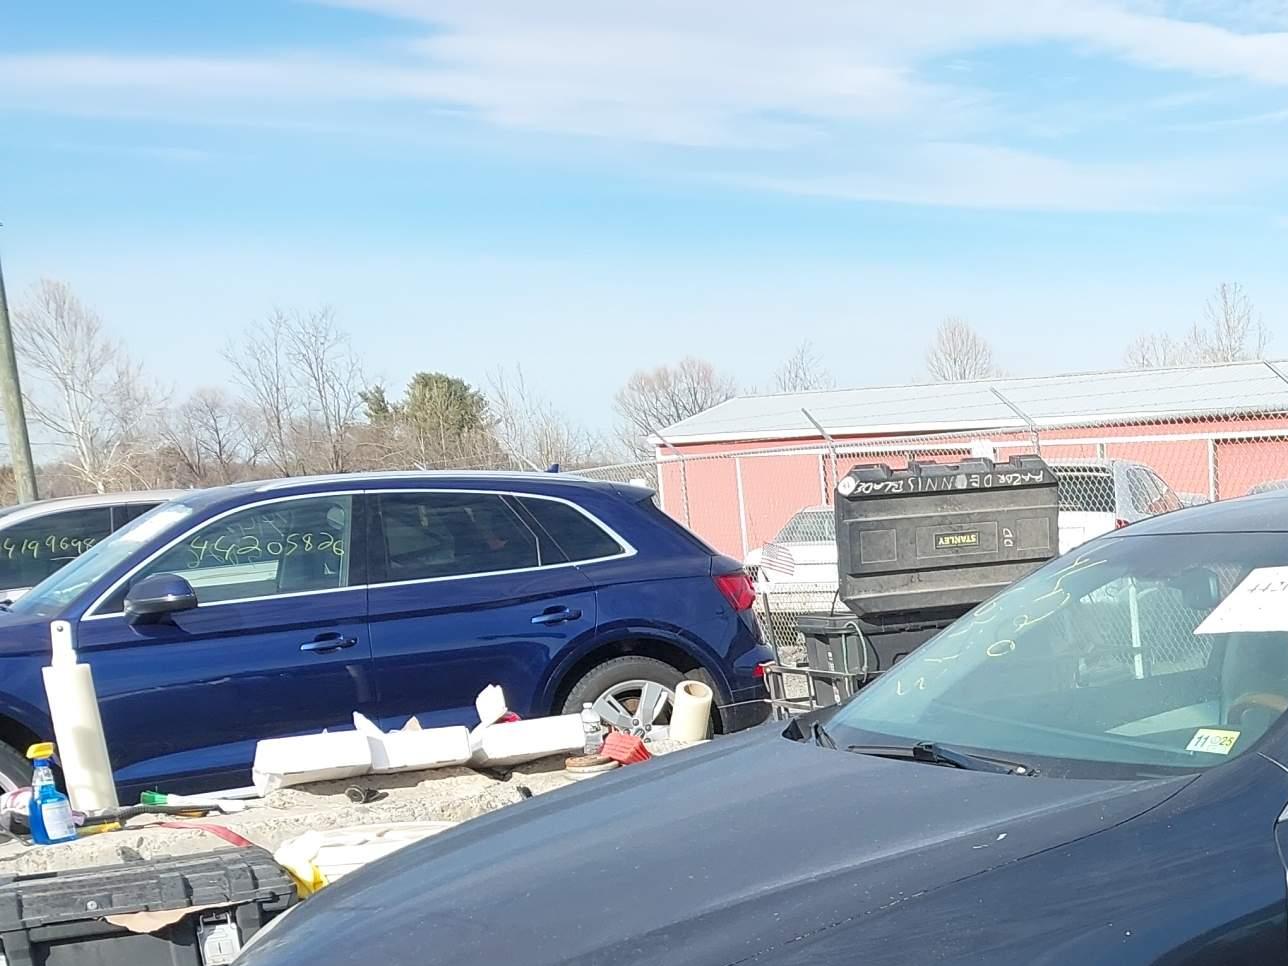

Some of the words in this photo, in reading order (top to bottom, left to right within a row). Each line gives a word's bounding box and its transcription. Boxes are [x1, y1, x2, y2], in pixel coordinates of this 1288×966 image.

[999, 470, 1044, 484] RAZOR
[853, 480, 904, 494] BLADE
[938, 534, 979, 546] STANLEY
[1219, 735, 1235, 747] 25
